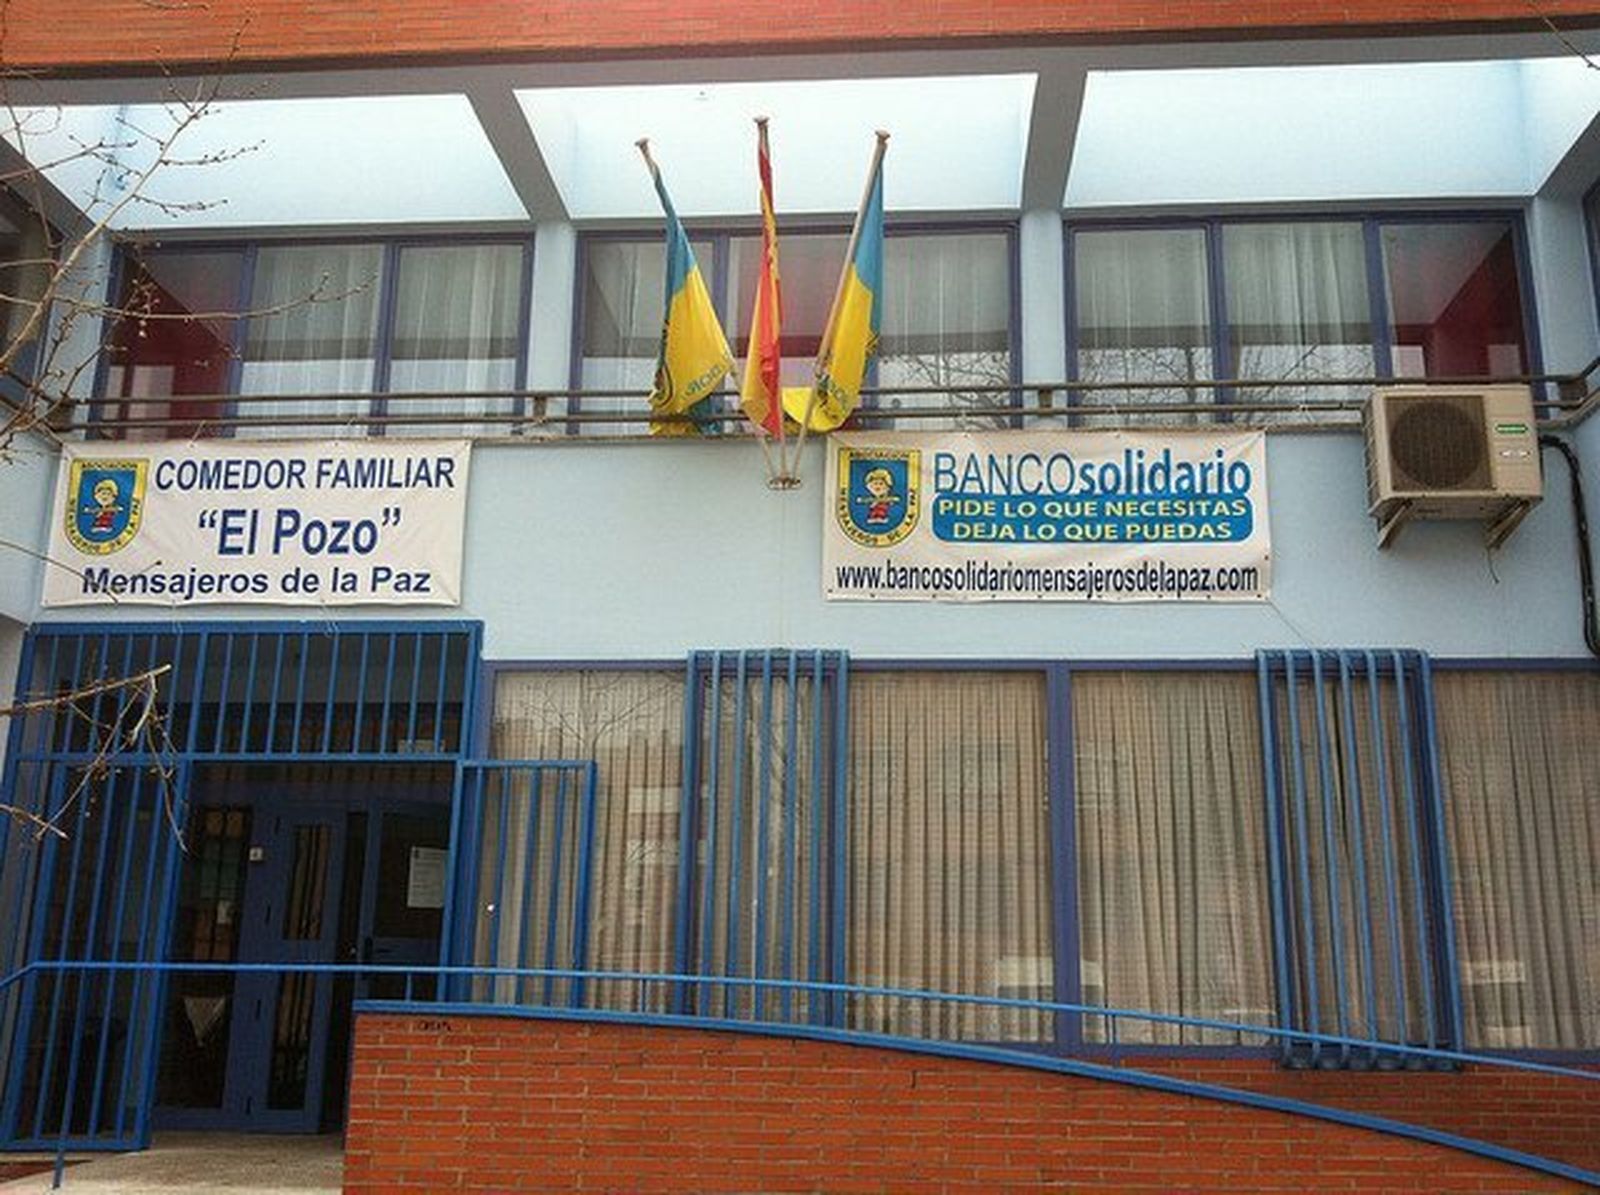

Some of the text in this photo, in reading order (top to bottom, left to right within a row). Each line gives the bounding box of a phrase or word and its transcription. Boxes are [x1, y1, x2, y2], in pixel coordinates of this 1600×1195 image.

[155, 457, 455, 490] COMEDOR FAMILIAR
[933, 447, 1251, 495] BANCOsolidario
[938, 498, 1247, 517] PIDE LO QUE NECESITAS
[953, 521, 1232, 540] DEJA LO QUE PUEDAS
[82, 567, 432, 600] Mensajeros de la Paz
[836, 560, 1258, 599] www.bancosolidariomensajerosdelapaz.com
